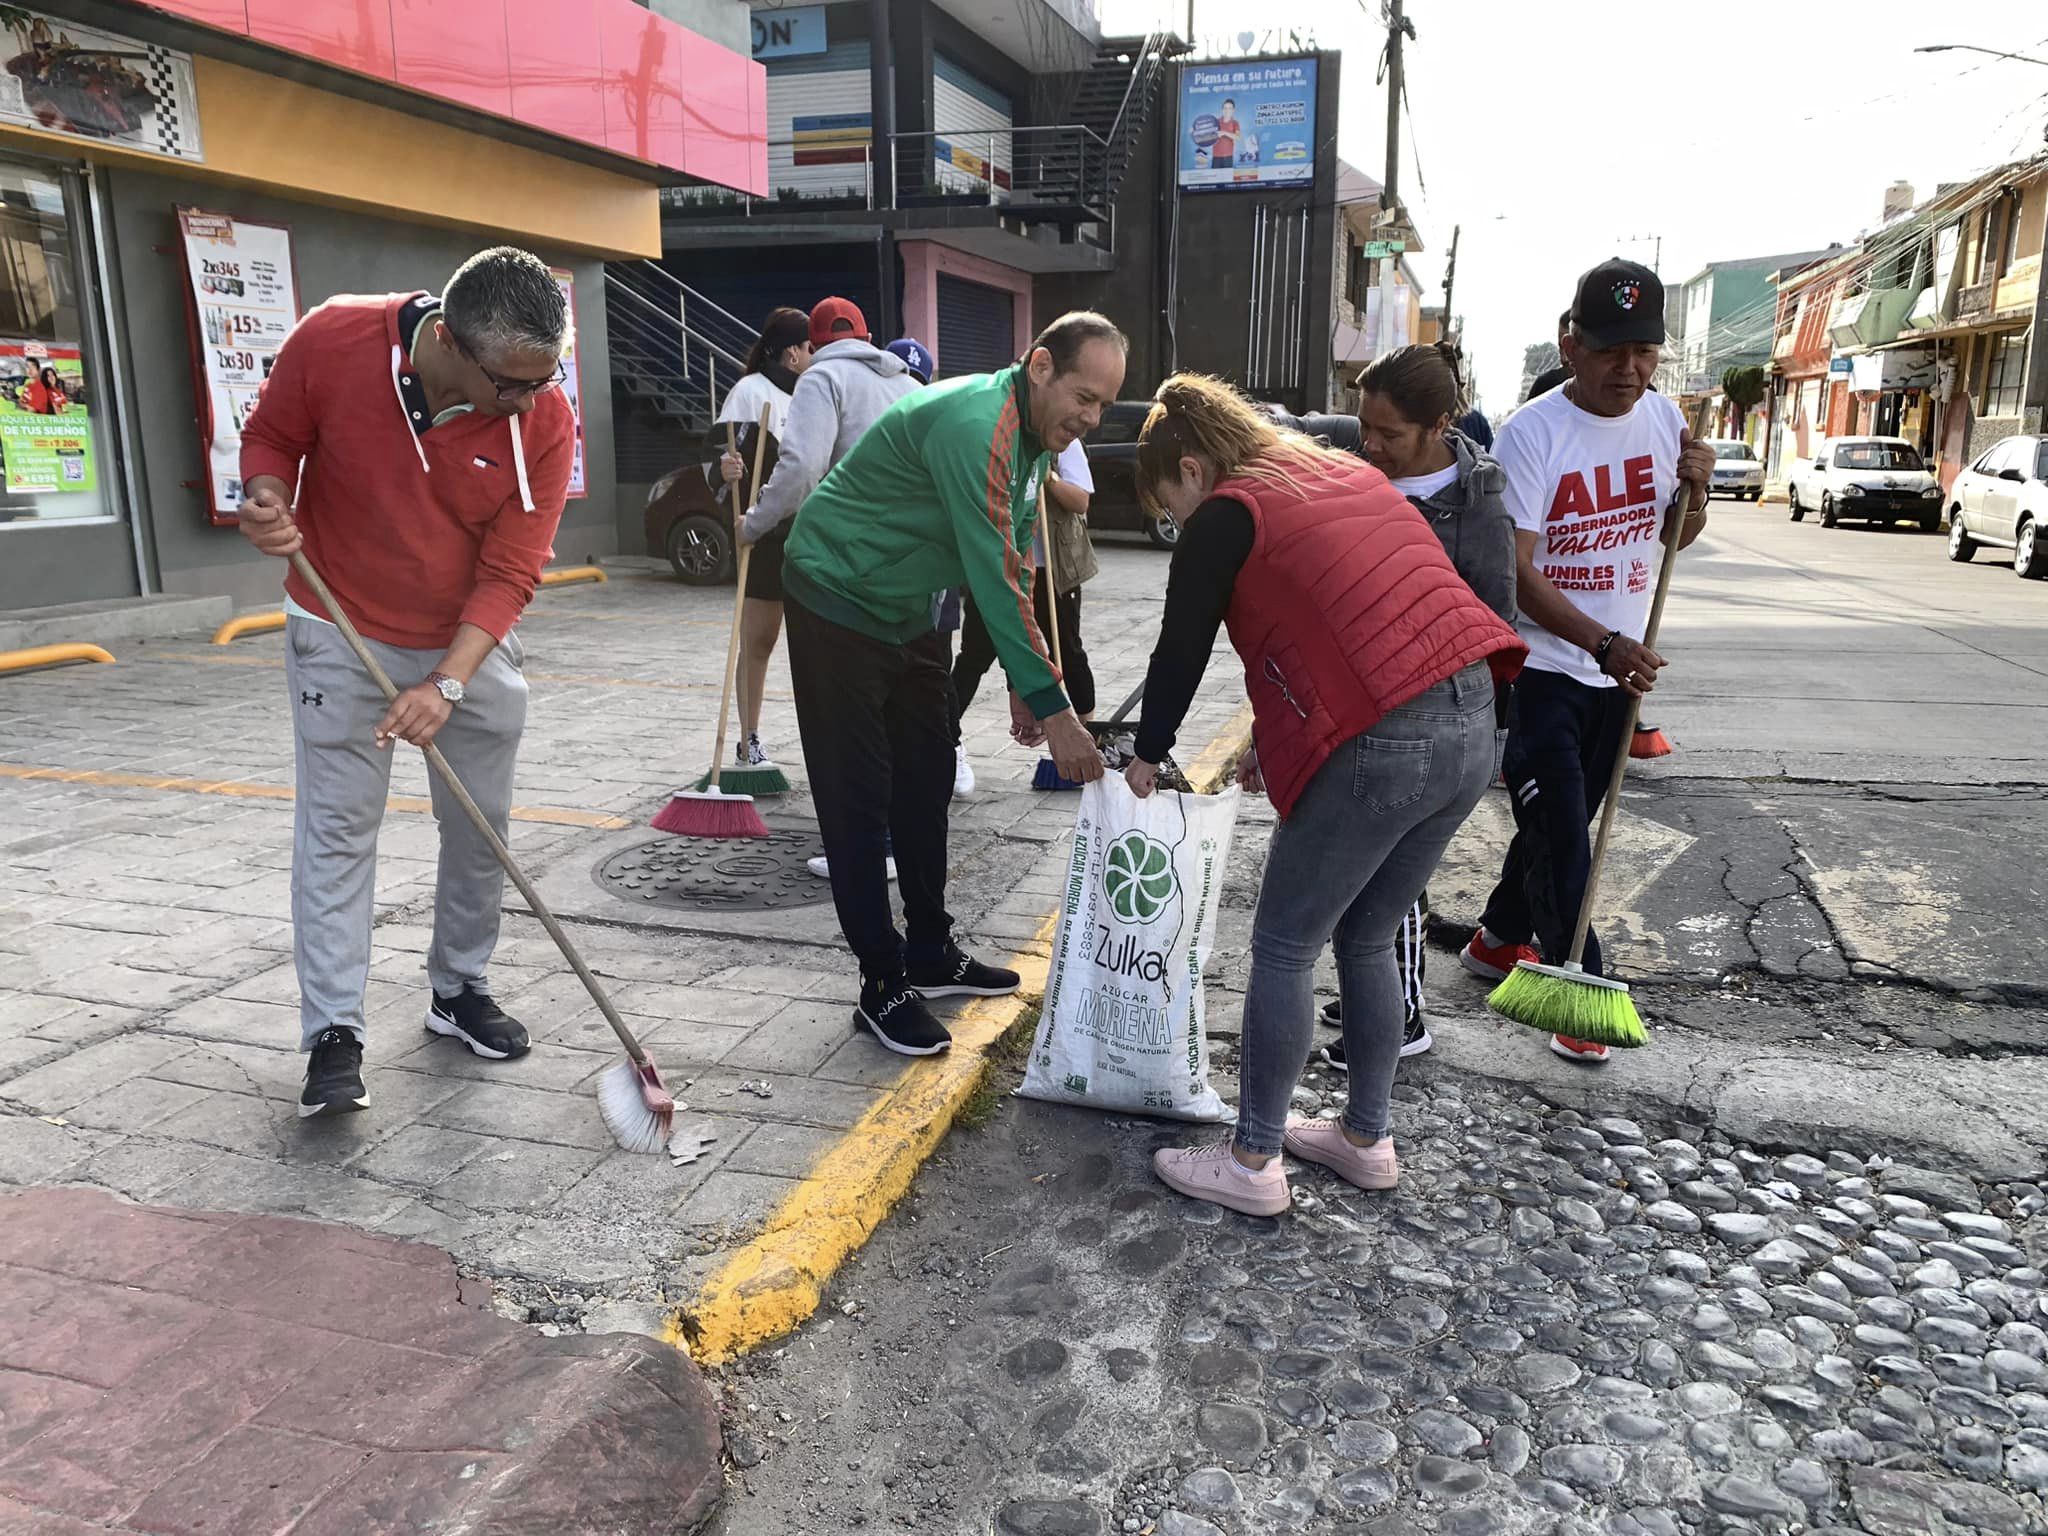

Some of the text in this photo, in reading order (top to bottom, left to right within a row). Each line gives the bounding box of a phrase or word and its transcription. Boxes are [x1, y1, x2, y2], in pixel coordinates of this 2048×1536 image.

[1194, 68, 1302, 85] Piensa en su futuro
[1251, 81, 1268, 90] para
[908, 346, 921, 366] LA
[4, 424, 87, 436] DE TUS SUEÑOS
[1545, 454, 1656, 522] ALE
[1546, 506, 1656, 536] GOBERNADORA
[1547, 520, 1656, 557] VALIENTE
[1543, 564, 1615, 580] UNIR ES
[1551, 580, 1615, 591] ESOLVER
[1072, 834, 1088, 873] AZÚCAR
[1202, 856, 1213, 897] NATURAL
[1066, 876, 1083, 916] MORENA
[1064, 920, 1073, 932] DE
[1194, 899, 1206, 933] ORIGEN
[1059, 933, 1070, 958] CAÑA
[1095, 924, 1164, 982] Zulka
[1190, 935, 1199, 947] DE
[1057, 959, 1066, 974] DE
[1187, 949, 1199, 974] CAÑA
[1051, 974, 1063, 1009] ORIGEN
[1101, 983, 1148, 1004] AZÚCAR
[1075, 987, 1172, 1046] MORENA
[1188, 996, 1198, 1037] MORE
[1073, 1026, 1084, 1035] DE
[1110, 1040, 1135, 1053] ORIGEN
[1136, 1047, 1171, 1055] NATURAL
[1187, 1037, 1199, 1077] AZÚCAR
[1109, 1064, 1116, 1073] LO
[1116, 1067, 1137, 1079] NATURAL
[1143, 1096, 1173, 1110] 25 kg
